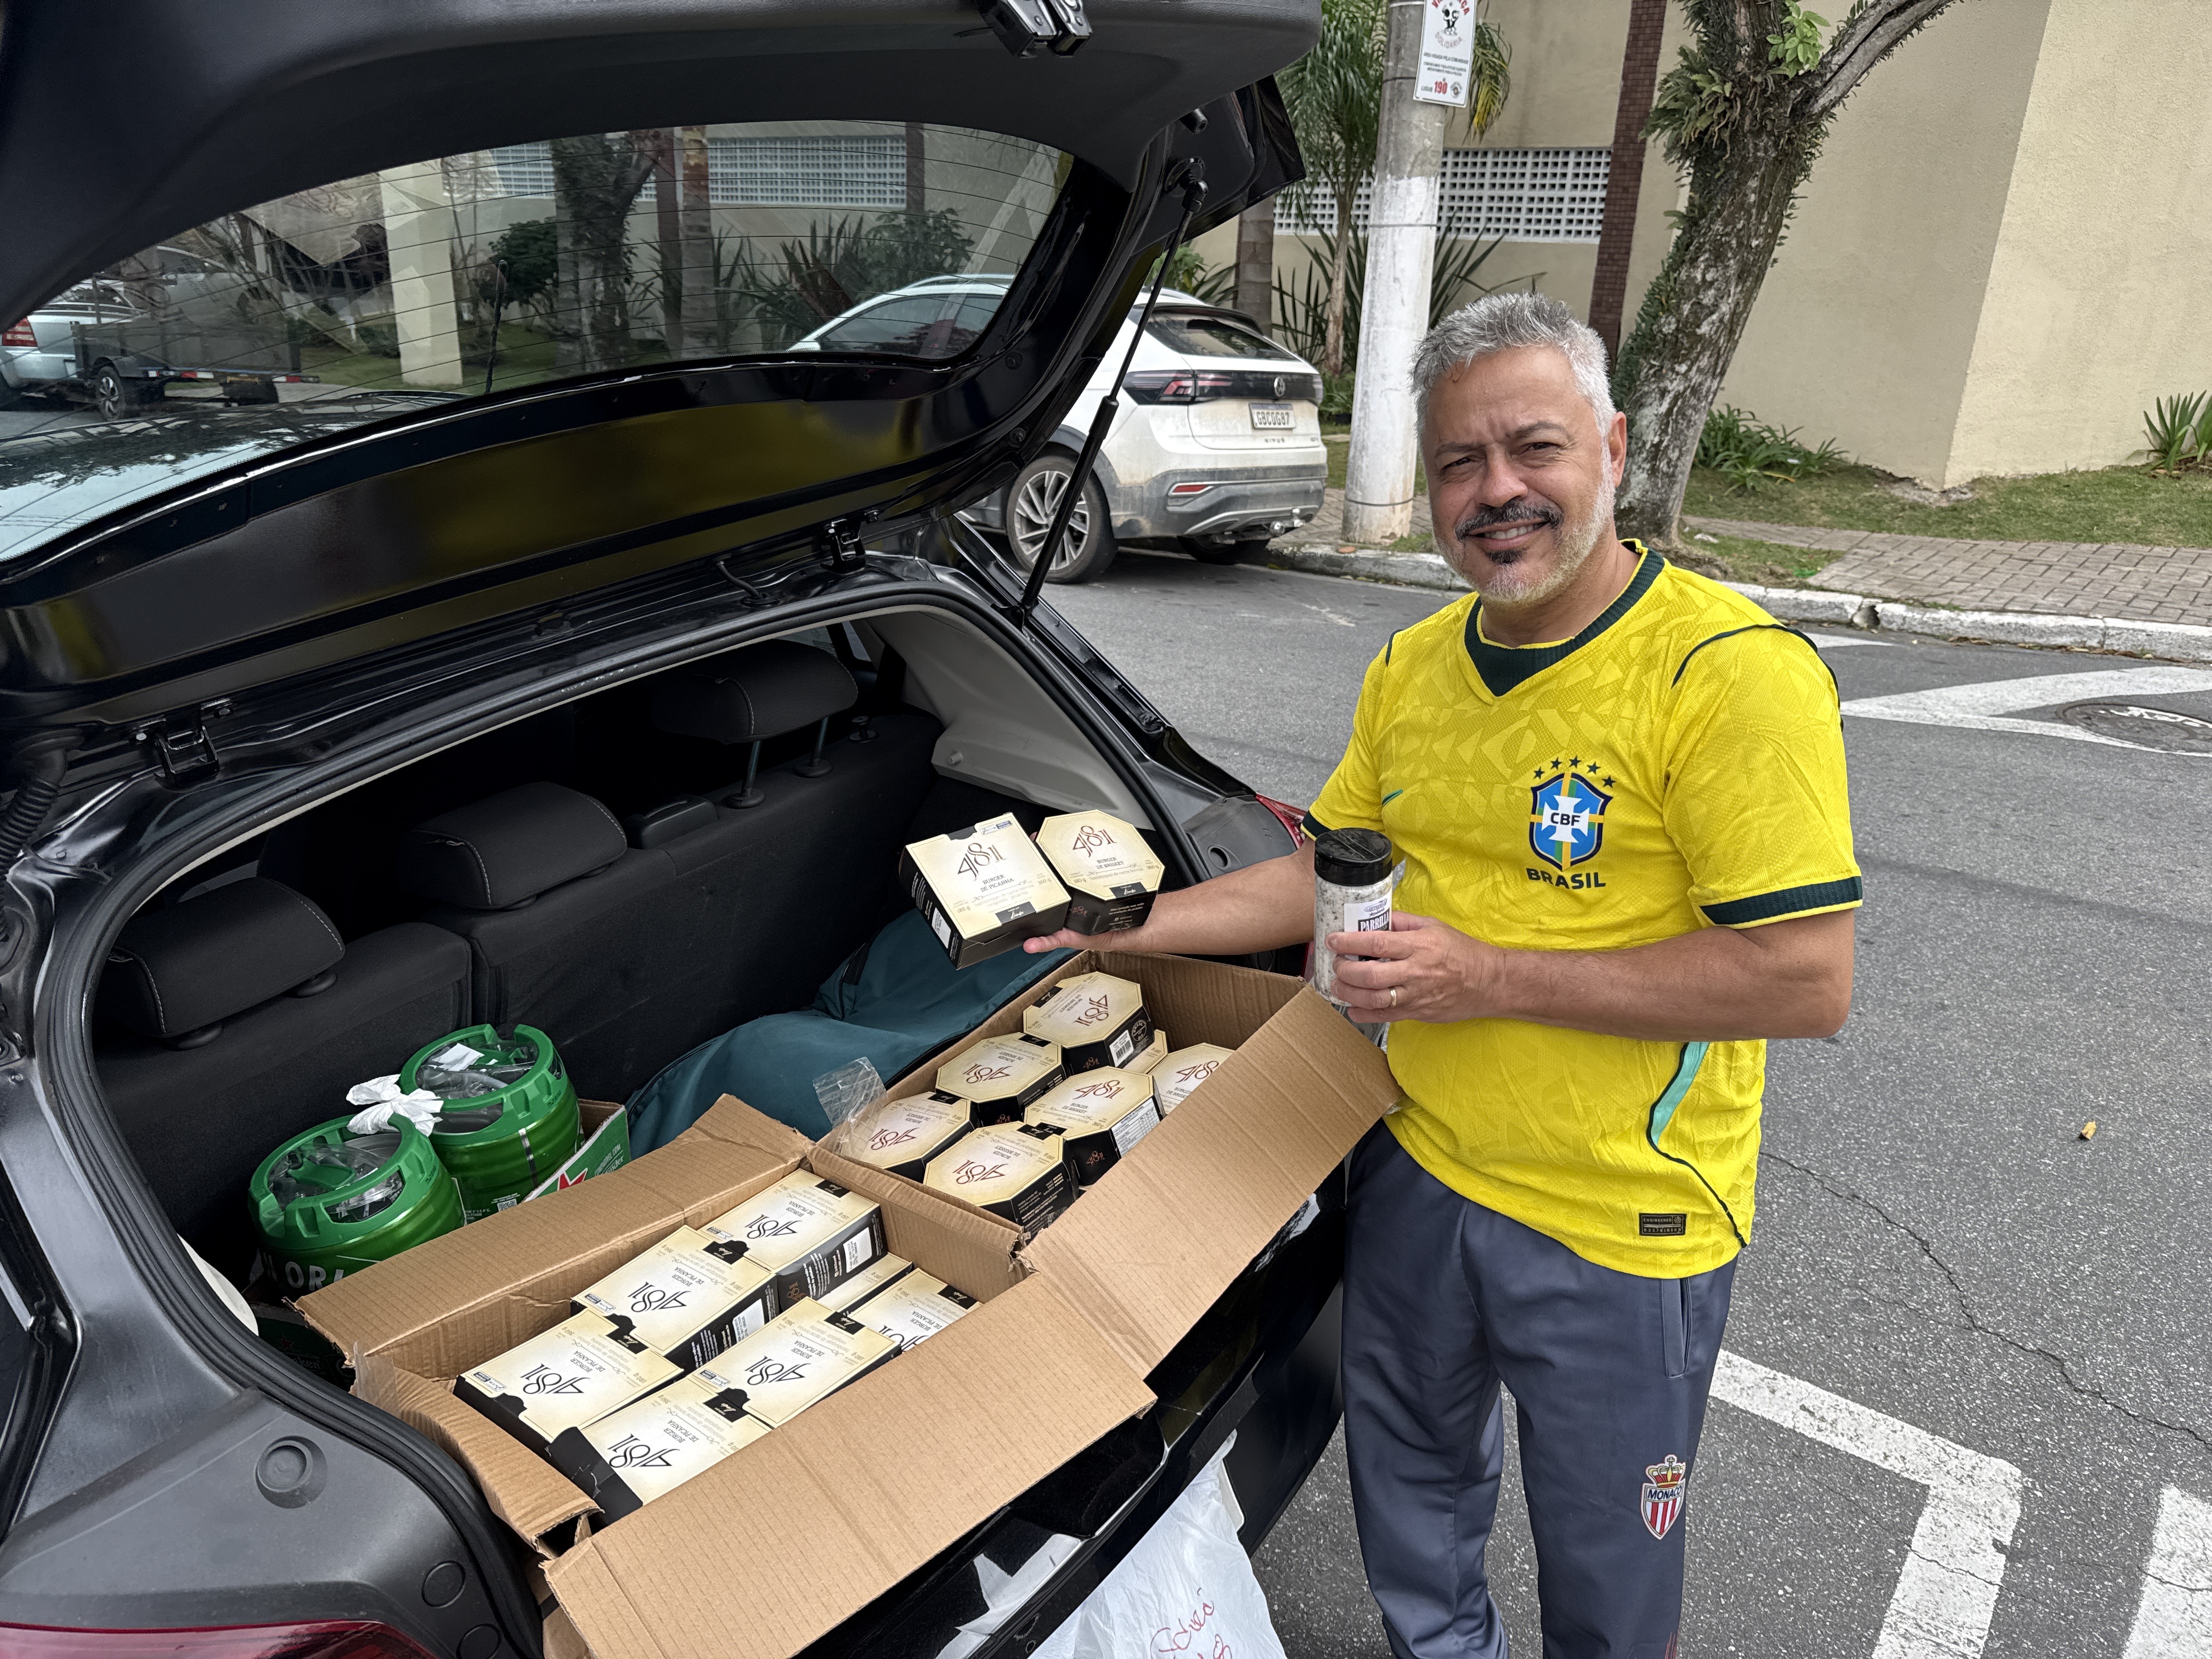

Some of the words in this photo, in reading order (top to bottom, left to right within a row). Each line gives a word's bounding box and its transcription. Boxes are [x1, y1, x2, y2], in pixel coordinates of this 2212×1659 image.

[1435, 81, 1447, 94] 190
[1550, 812, 1581, 826] CBF
[1073, 826, 1117, 857] 481
[957, 843, 1007, 881] 481
[982, 874, 1005, 885] BURGER
[988, 878, 1014, 889] PICANHA
[1526, 868, 1606, 889] BRASIL
[1059, 1000, 1075, 1013] BRISKET
[1067, 998, 1083, 1012] BURGER
[1073, 994, 1109, 1026] 481
[962, 1063, 1013, 1084] 481
[1175, 1060, 1219, 1084] 48
[1073, 1080, 1125, 1099] 481
[870, 1127, 920, 1150] 481
[992, 1150, 1012, 1159] BURGER
[952, 1160, 1008, 1184] 481
[786, 1207, 804, 1217] BURGER
[789, 1201, 808, 1211] PICANHA
[744, 1214, 803, 1239] 481
[672, 1273, 693, 1287] BURGER
[674, 1267, 698, 1282] PICANHA
[628, 1282, 692, 1312] 481
[910, 1318, 932, 1331] BURGER
[912, 1311, 933, 1326] PICANHA
[791, 1347, 813, 1359] BURGER
[795, 1340, 817, 1354] PICANHA
[571, 1357, 593, 1373] BURGER
[573, 1350, 597, 1368] PICANHA
[595, 1364, 606, 1373] DE
[744, 1356, 811, 1386] 481
[520, 1363, 590, 1394] 481
[639, 1375, 647, 1384] 180
[663, 1427, 686, 1443] BURGER
[667, 1419, 692, 1438] PICANHA
[607, 1433, 680, 1468] 481
[1647, 1486, 1681, 1500] MONACO
